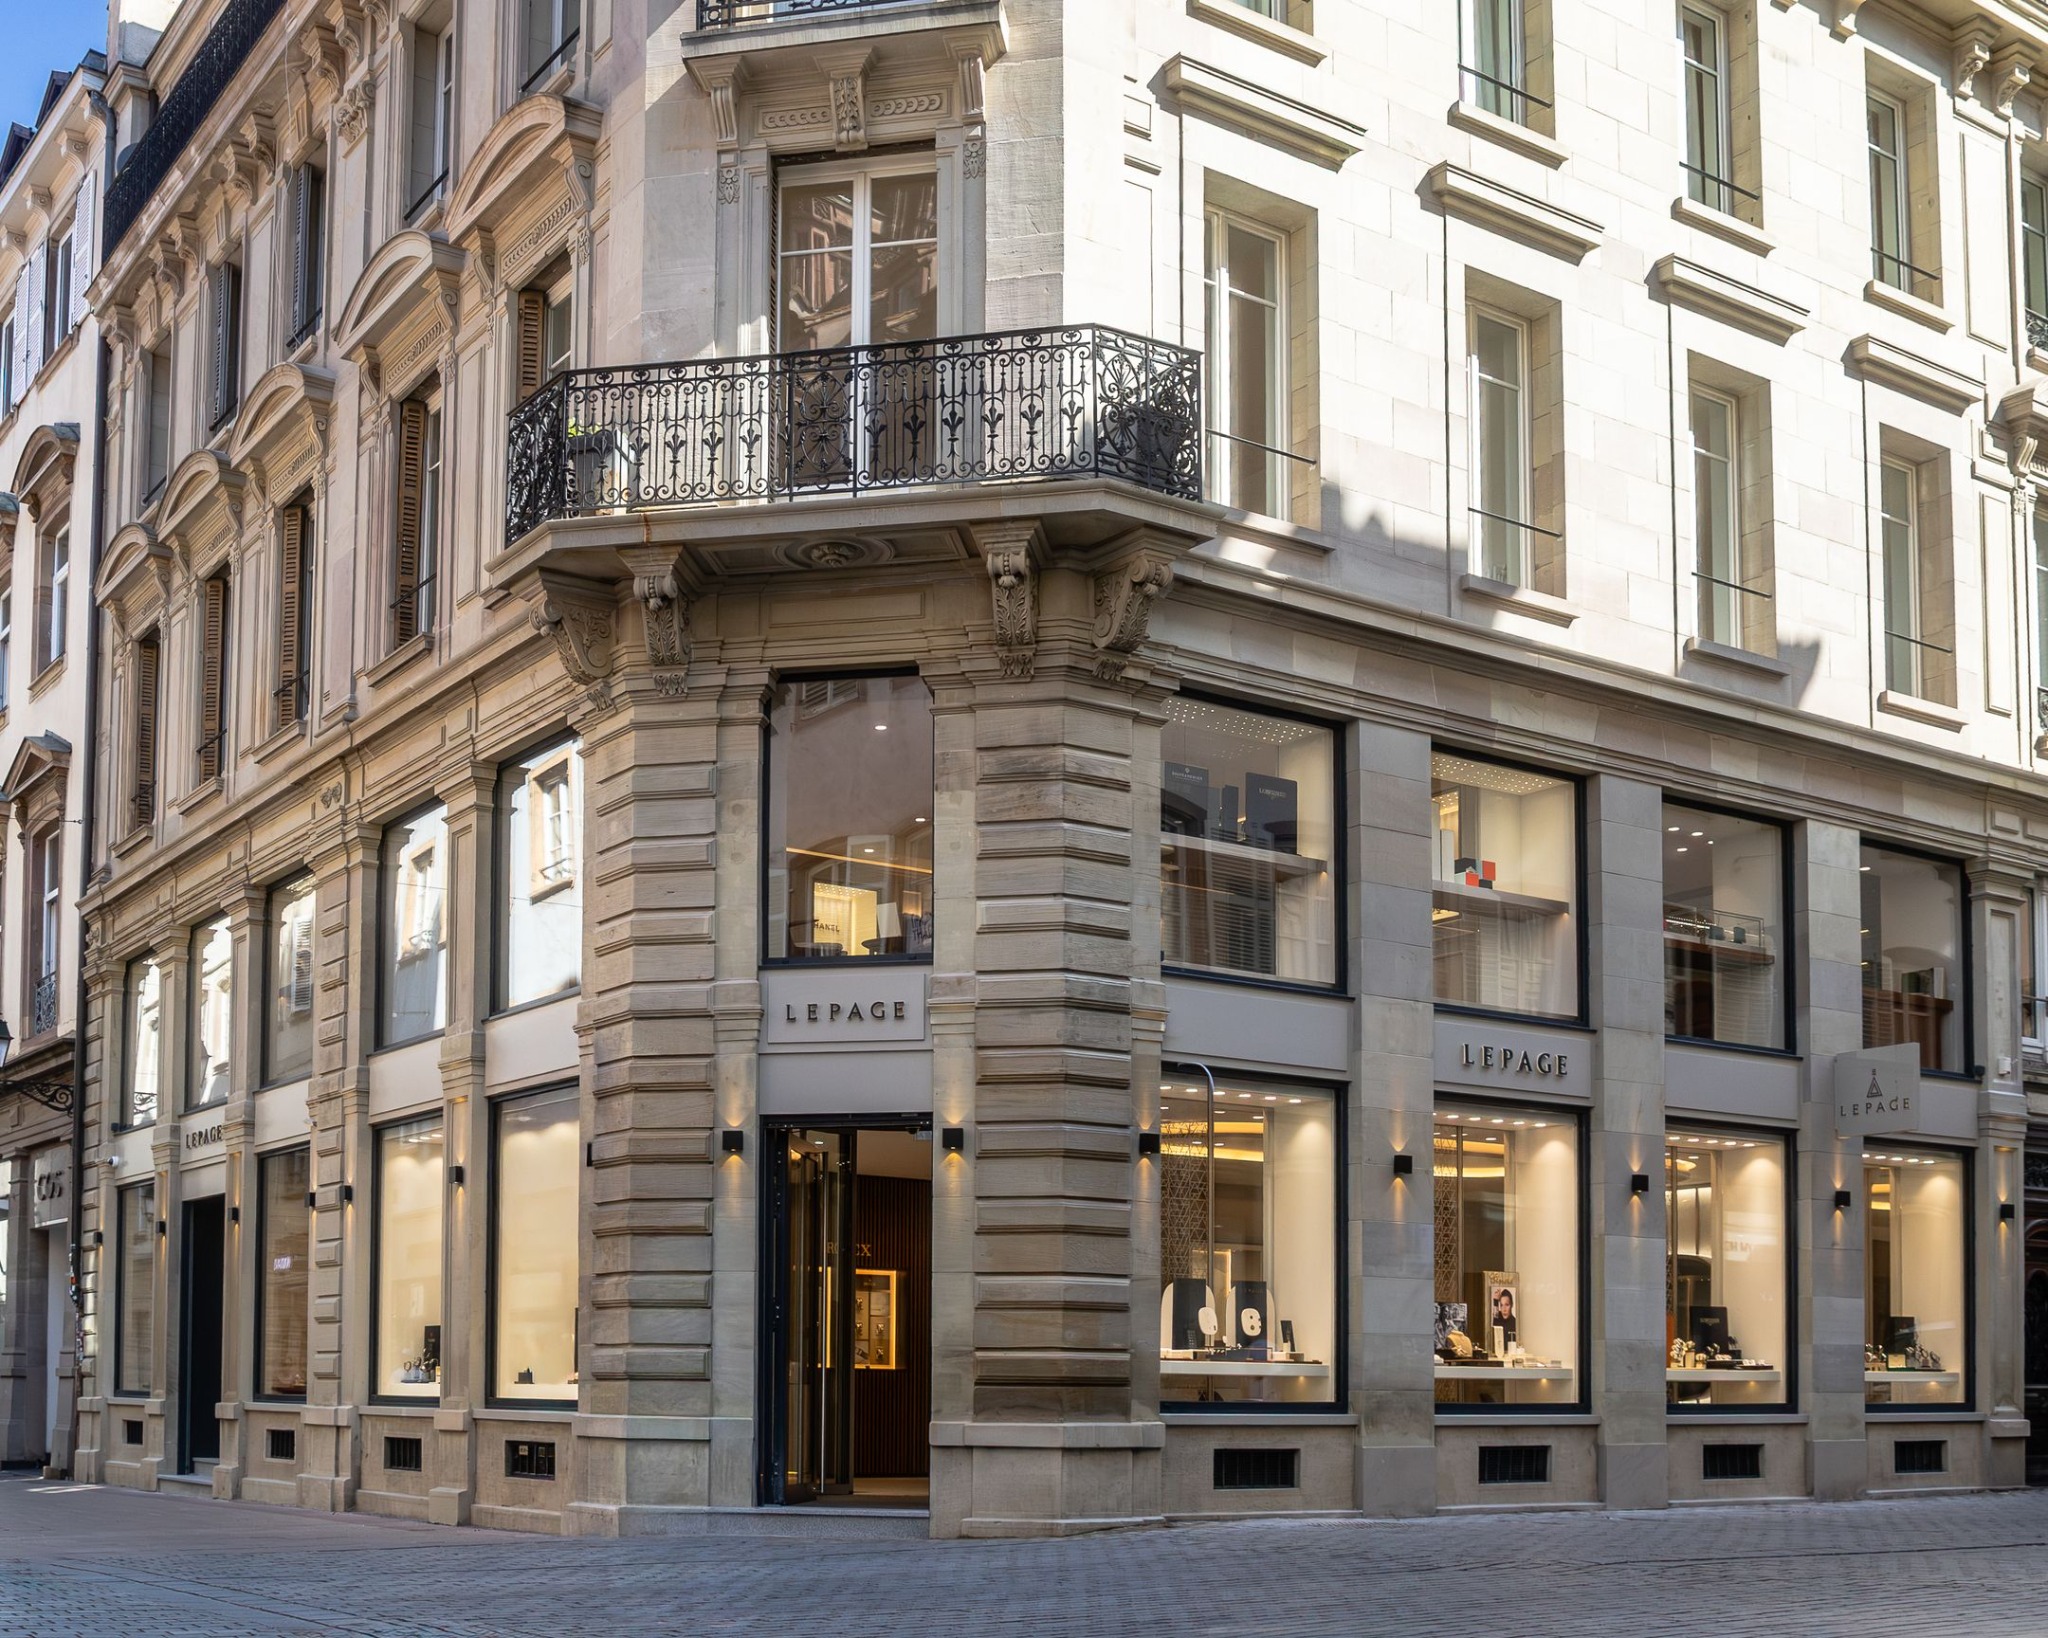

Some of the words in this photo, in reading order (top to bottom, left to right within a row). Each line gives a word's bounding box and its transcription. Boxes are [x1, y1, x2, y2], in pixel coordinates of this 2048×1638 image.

[813, 922, 840, 933] HANEL
[785, 1001, 905, 1021] LEPAGE
[1462, 1043, 1568, 1076] LEPAGE
[1840, 1097, 1910, 1117] LEPAGE
[185, 1124, 222, 1150] LEPAGE
